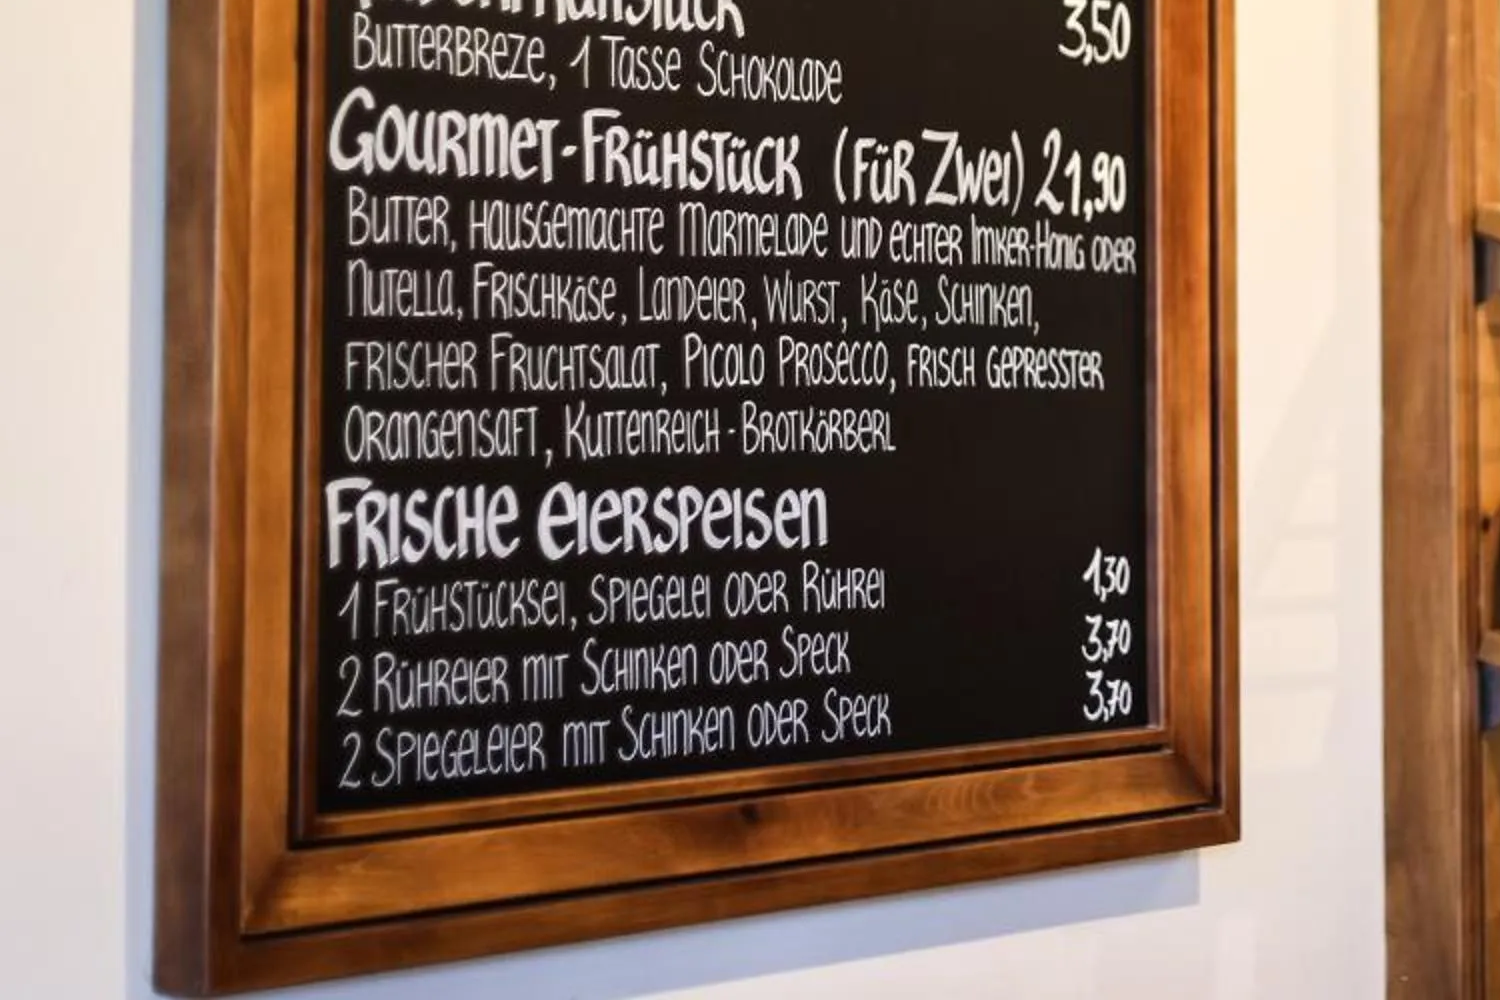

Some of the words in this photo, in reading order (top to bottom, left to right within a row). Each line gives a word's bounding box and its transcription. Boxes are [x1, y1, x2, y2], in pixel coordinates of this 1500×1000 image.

[352, 10, 557, 91] Butterbreze,
[568, 34, 591, 89] 1
[598, 33, 682, 92] Tasse
[695, 38, 843, 105] Schokolade
[832, 124, 917, 207] (für
[920, 127, 1025, 217] Zwei)
[1032, 126, 1127, 223] 21,90
[347, 184, 457, 253] Butter,
[467, 198, 665, 256] hausgemachte
[677, 200, 829, 258] Marmelade
[839, 214, 883, 260] und
[887, 218, 963, 267] echter
[969, 211, 1086, 272] Imker-Honig
[1089, 233, 1137, 275] oder
[346, 256, 463, 321] Nutella,
[471, 260, 627, 326] Frischkäse,
[638, 264, 757, 331] Landeier,
[762, 268, 848, 334] Wurst,
[859, 270, 927, 333] Käse,
[934, 272, 1040, 336] Schinken,
[344, 339, 477, 391] frischer
[489, 330, 667, 397] Fruchtsalat,
[682, 330, 765, 389] Picolo
[777, 333, 897, 395] Prosecco,
[906, 342, 976, 389] frisch
[984, 343, 1105, 391] gepresster
[343, 403, 553, 468] Orangensaft,
[323, 475, 521, 571] Frische
[535, 480, 829, 561] Eierspeisen
[337, 579, 360, 640] 1
[373, 576, 577, 638] Frühstücksei,
[587, 572, 711, 626] Spiegelei
[722, 568, 789, 619] oder
[801, 558, 885, 614] Rührei
[1081, 545, 1131, 603] 1,30
[335, 653, 362, 718] 2
[372, 650, 509, 713] Rühreier
[521, 652, 569, 701] mit
[579, 636, 697, 696] Schinken
[708, 638, 770, 685] oder
[778, 623, 851, 679] Speck
[1080, 612, 1132, 664] 3,70
[1081, 668, 1133, 723] 3,70
[338, 730, 362, 789] 2
[369, 720, 546, 788] Spiegeleier
[562, 718, 611, 767] mit
[616, 703, 735, 762] Schinken
[745, 696, 810, 748] oder
[820, 686, 892, 743] Speck
